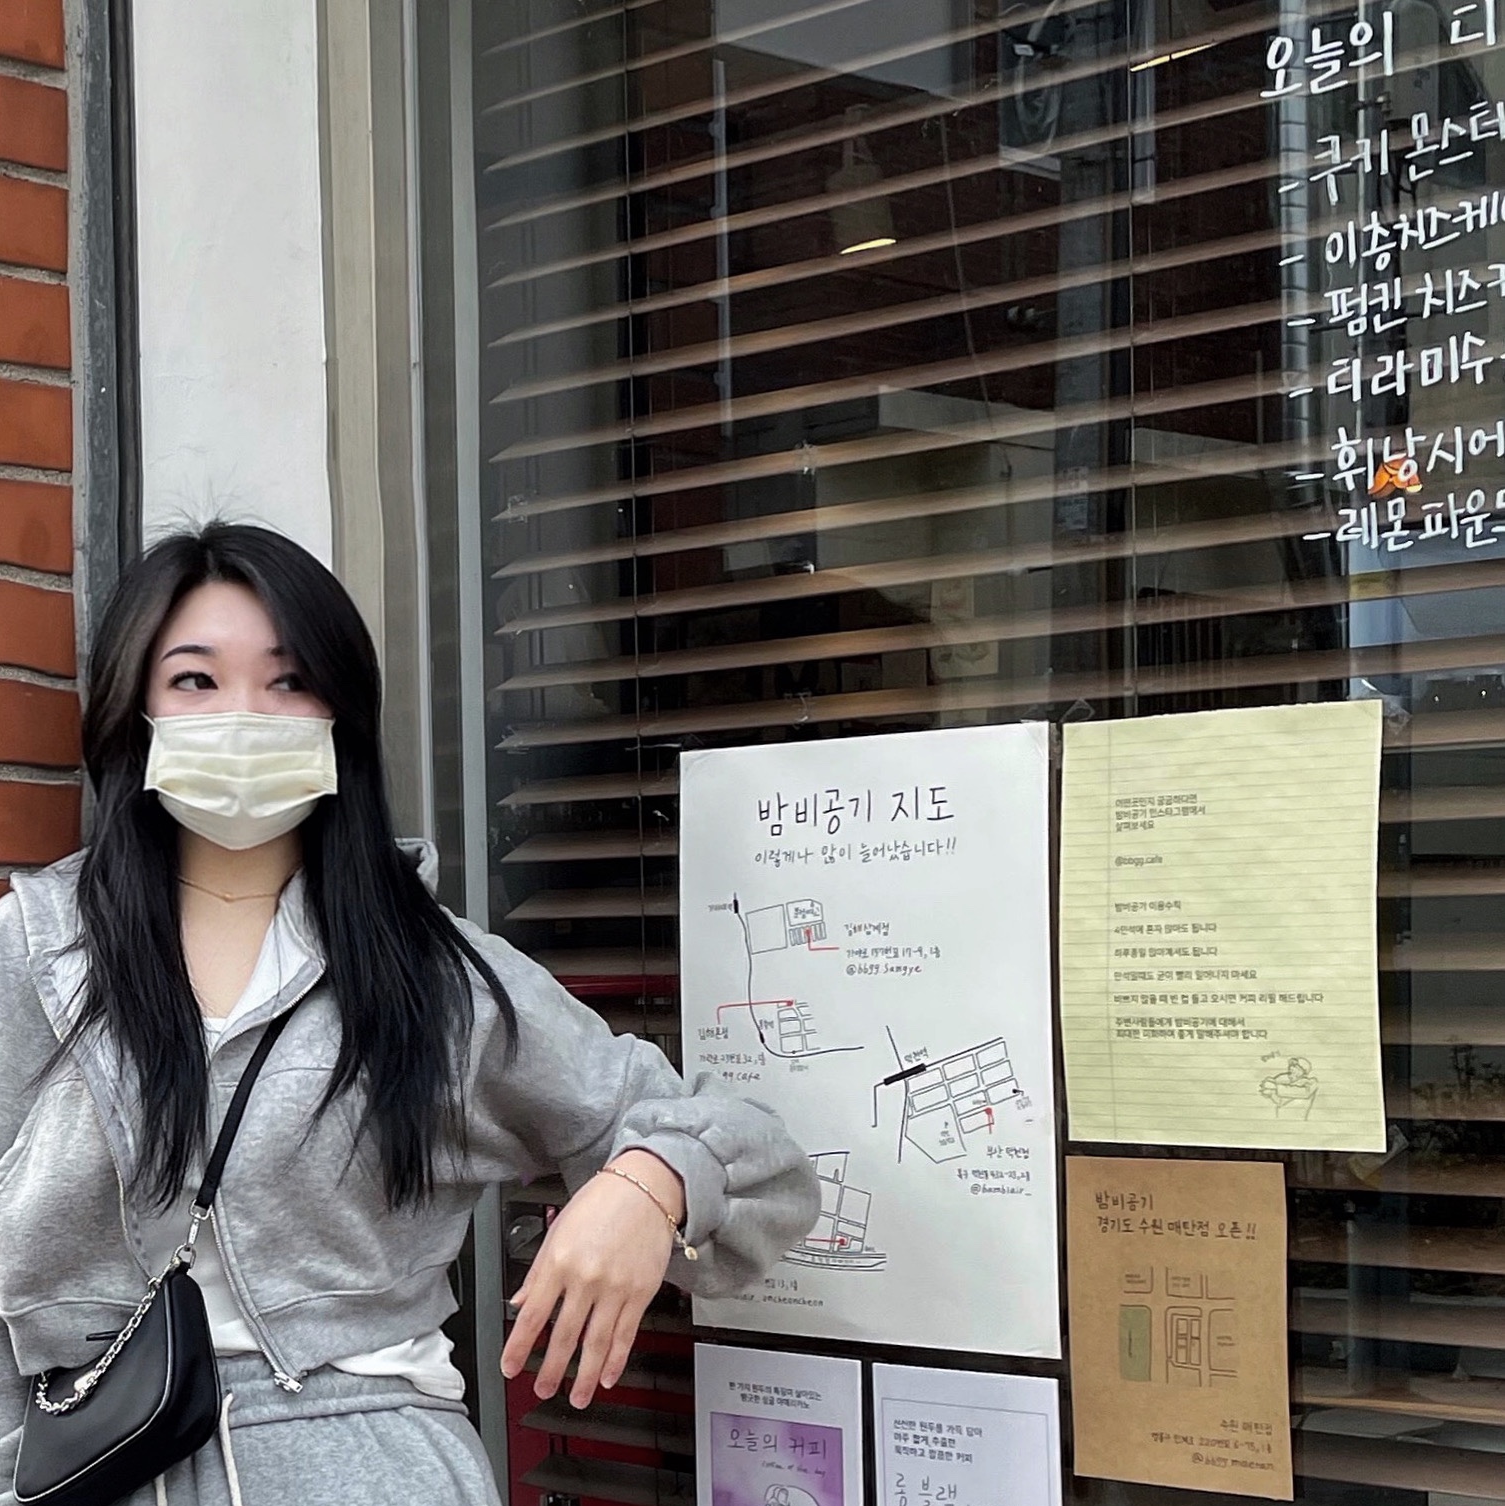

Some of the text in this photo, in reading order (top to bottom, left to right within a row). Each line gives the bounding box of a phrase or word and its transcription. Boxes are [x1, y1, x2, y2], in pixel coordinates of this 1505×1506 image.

[1260, 11, 1393, 97] 오늘의
[1309, 101, 1505, 205] 쿠키 몬스터
[1325, 192, 1505, 271] 이층치즈케
[1336, 488, 1505, 552] 레몬파운
[1157, 793, 1197, 806] 궁금하다면
[757, 785, 955, 836] 밤비공기 지도
[1149, 805, 1206, 819] 인스타그램에서
[755, 847, 814, 868] 이렇게나
[1146, 924, 1163, 935] 혼자
[1191, 922, 1217, 934] 됩니다
[1114, 947, 1147, 958] 하루종일
[1192, 946, 1218, 957] 됩니다
[1176, 970, 1193, 981] 빨리
[1195, 969, 1229, 981] 일어나지
[1231, 969, 1258, 980] 마세요
[1211, 993, 1237, 1004] 오시면
[1239, 993, 1257, 1004] 커피
[1259, 993, 1277, 1004] 리필
[1279, 993, 1325, 1004] 해드립니다
[1218, 1016, 1245, 1028] 대해서
[1241, 1029, 1268, 1040] 합니다
[1095, 1190, 1154, 1212] 밤비공기
[1097, 1216, 1135, 1234] 경기도
[1138, 1218, 1164, 1236] 수원
[1167, 1219, 1210, 1238] 매탄점
[727, 1428, 826, 1460] 오늘의 커피
